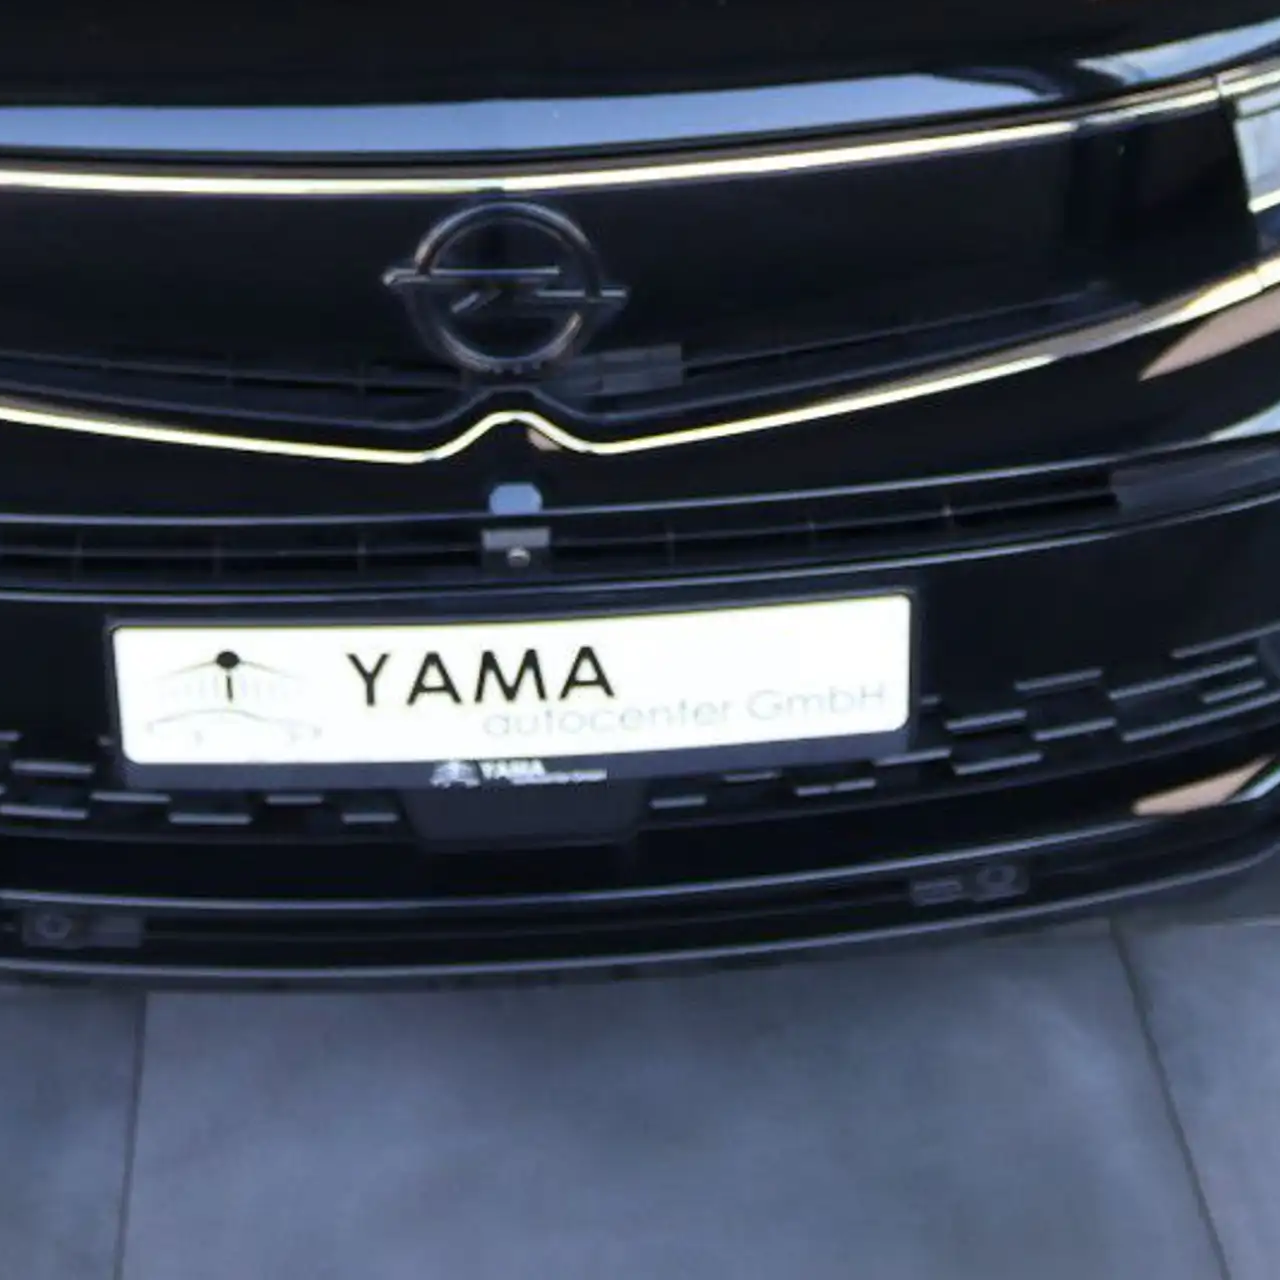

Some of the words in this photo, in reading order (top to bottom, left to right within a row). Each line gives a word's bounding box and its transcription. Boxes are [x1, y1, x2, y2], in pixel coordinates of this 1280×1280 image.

[346, 646, 616, 707] YAMA
[481, 698, 731, 737] autocenter
[745, 681, 886, 721] GmbH
